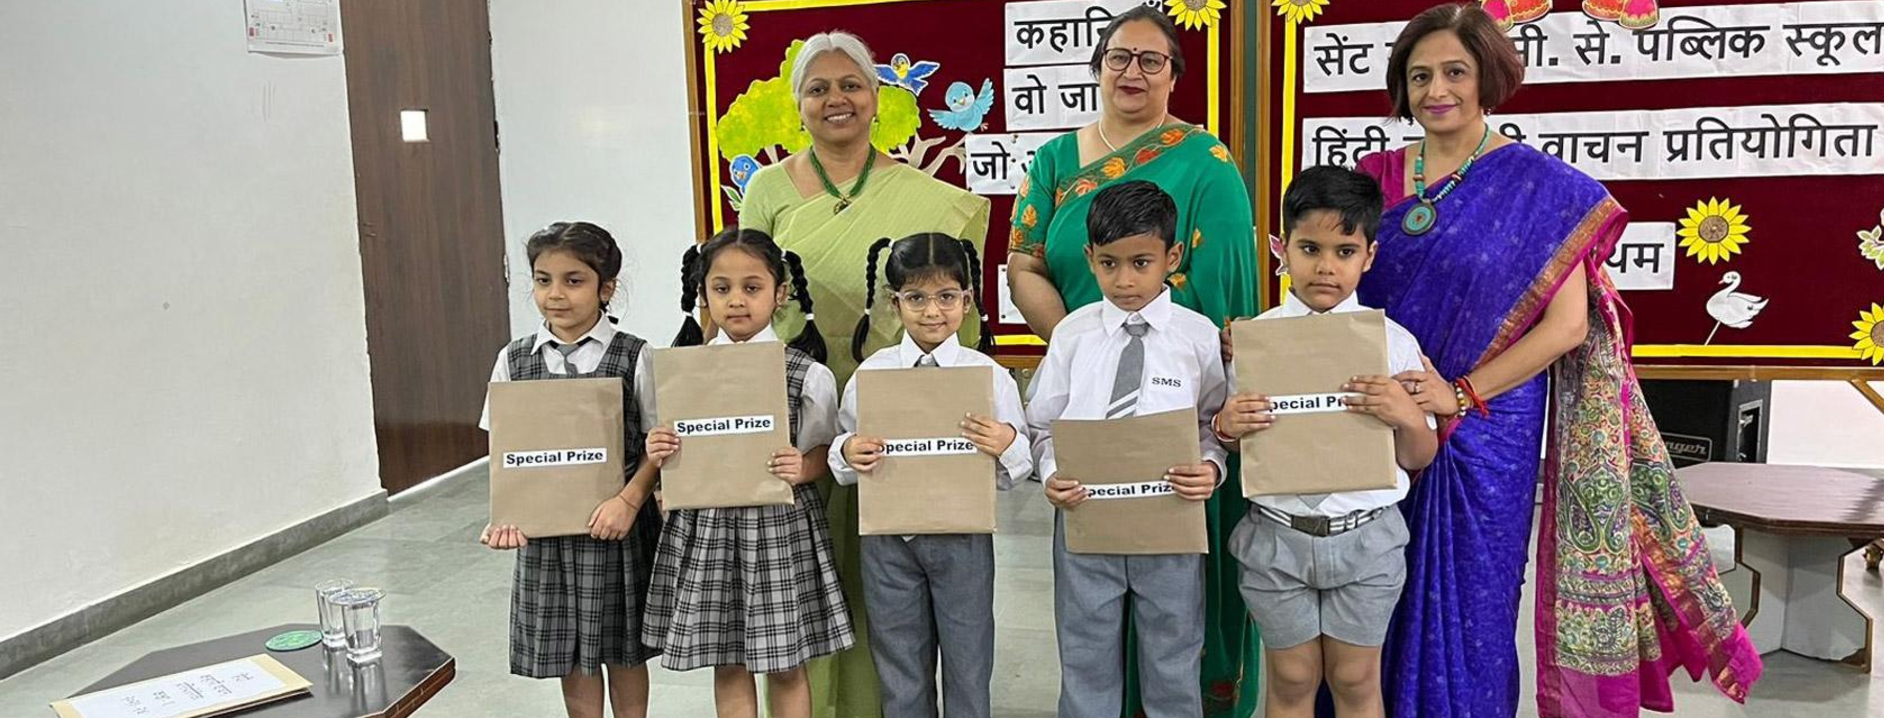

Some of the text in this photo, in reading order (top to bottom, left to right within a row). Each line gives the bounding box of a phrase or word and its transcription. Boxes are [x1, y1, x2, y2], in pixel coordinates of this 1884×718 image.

[1314, 33, 1374, 76] सेंट
[1573, 20, 1621, 65] से.
[1633, 15, 1770, 61] पब्लिक
[1783, 22, 1884, 66] स्कूल
[1012, 74, 1100, 114] वो जा
[1538, 131, 1649, 163] वाचन
[1663, 113, 1878, 162] प्रतियोगिता
[970, 141, 1011, 180] जो
[1152, 376, 1181, 388] SMS
[1268, 397, 1320, 413] pecial
[677, 418, 771, 435] Special Prize
[937, 440, 974, 451] Prize
[1666, 441, 1707, 455] nger
[506, 450, 604, 466] Special Prize
[1086, 483, 1175, 498] pecial Priz
